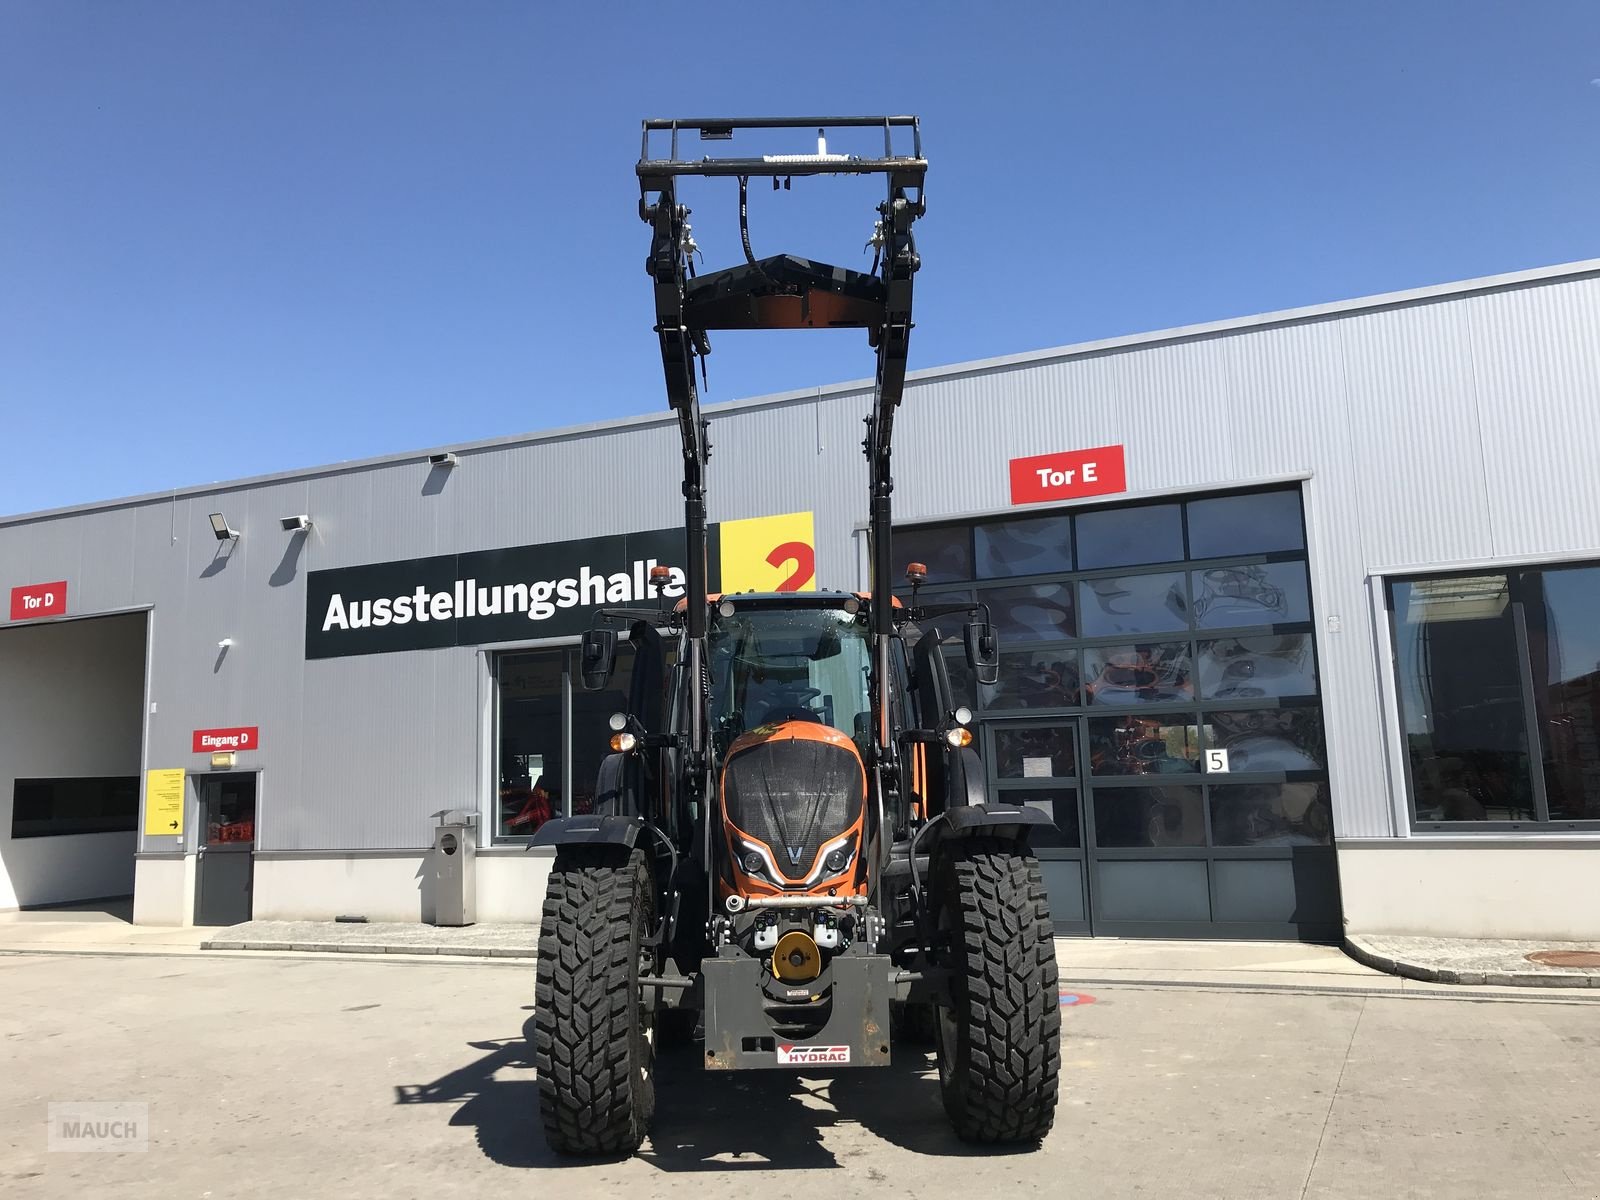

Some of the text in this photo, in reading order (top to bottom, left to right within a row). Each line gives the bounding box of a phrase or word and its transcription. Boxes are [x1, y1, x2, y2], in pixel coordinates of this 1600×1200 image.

[1036, 462, 1098, 488] Tor E
[765, 541, 815, 592] 2
[23, 592, 54, 609] Tor D
[321, 558, 687, 632] Ausstellungshalle
[201, 733, 249, 747] Eingang D
[1211, 752, 1223, 770] 5
[789, 1053, 847, 1062] HYDRAC
